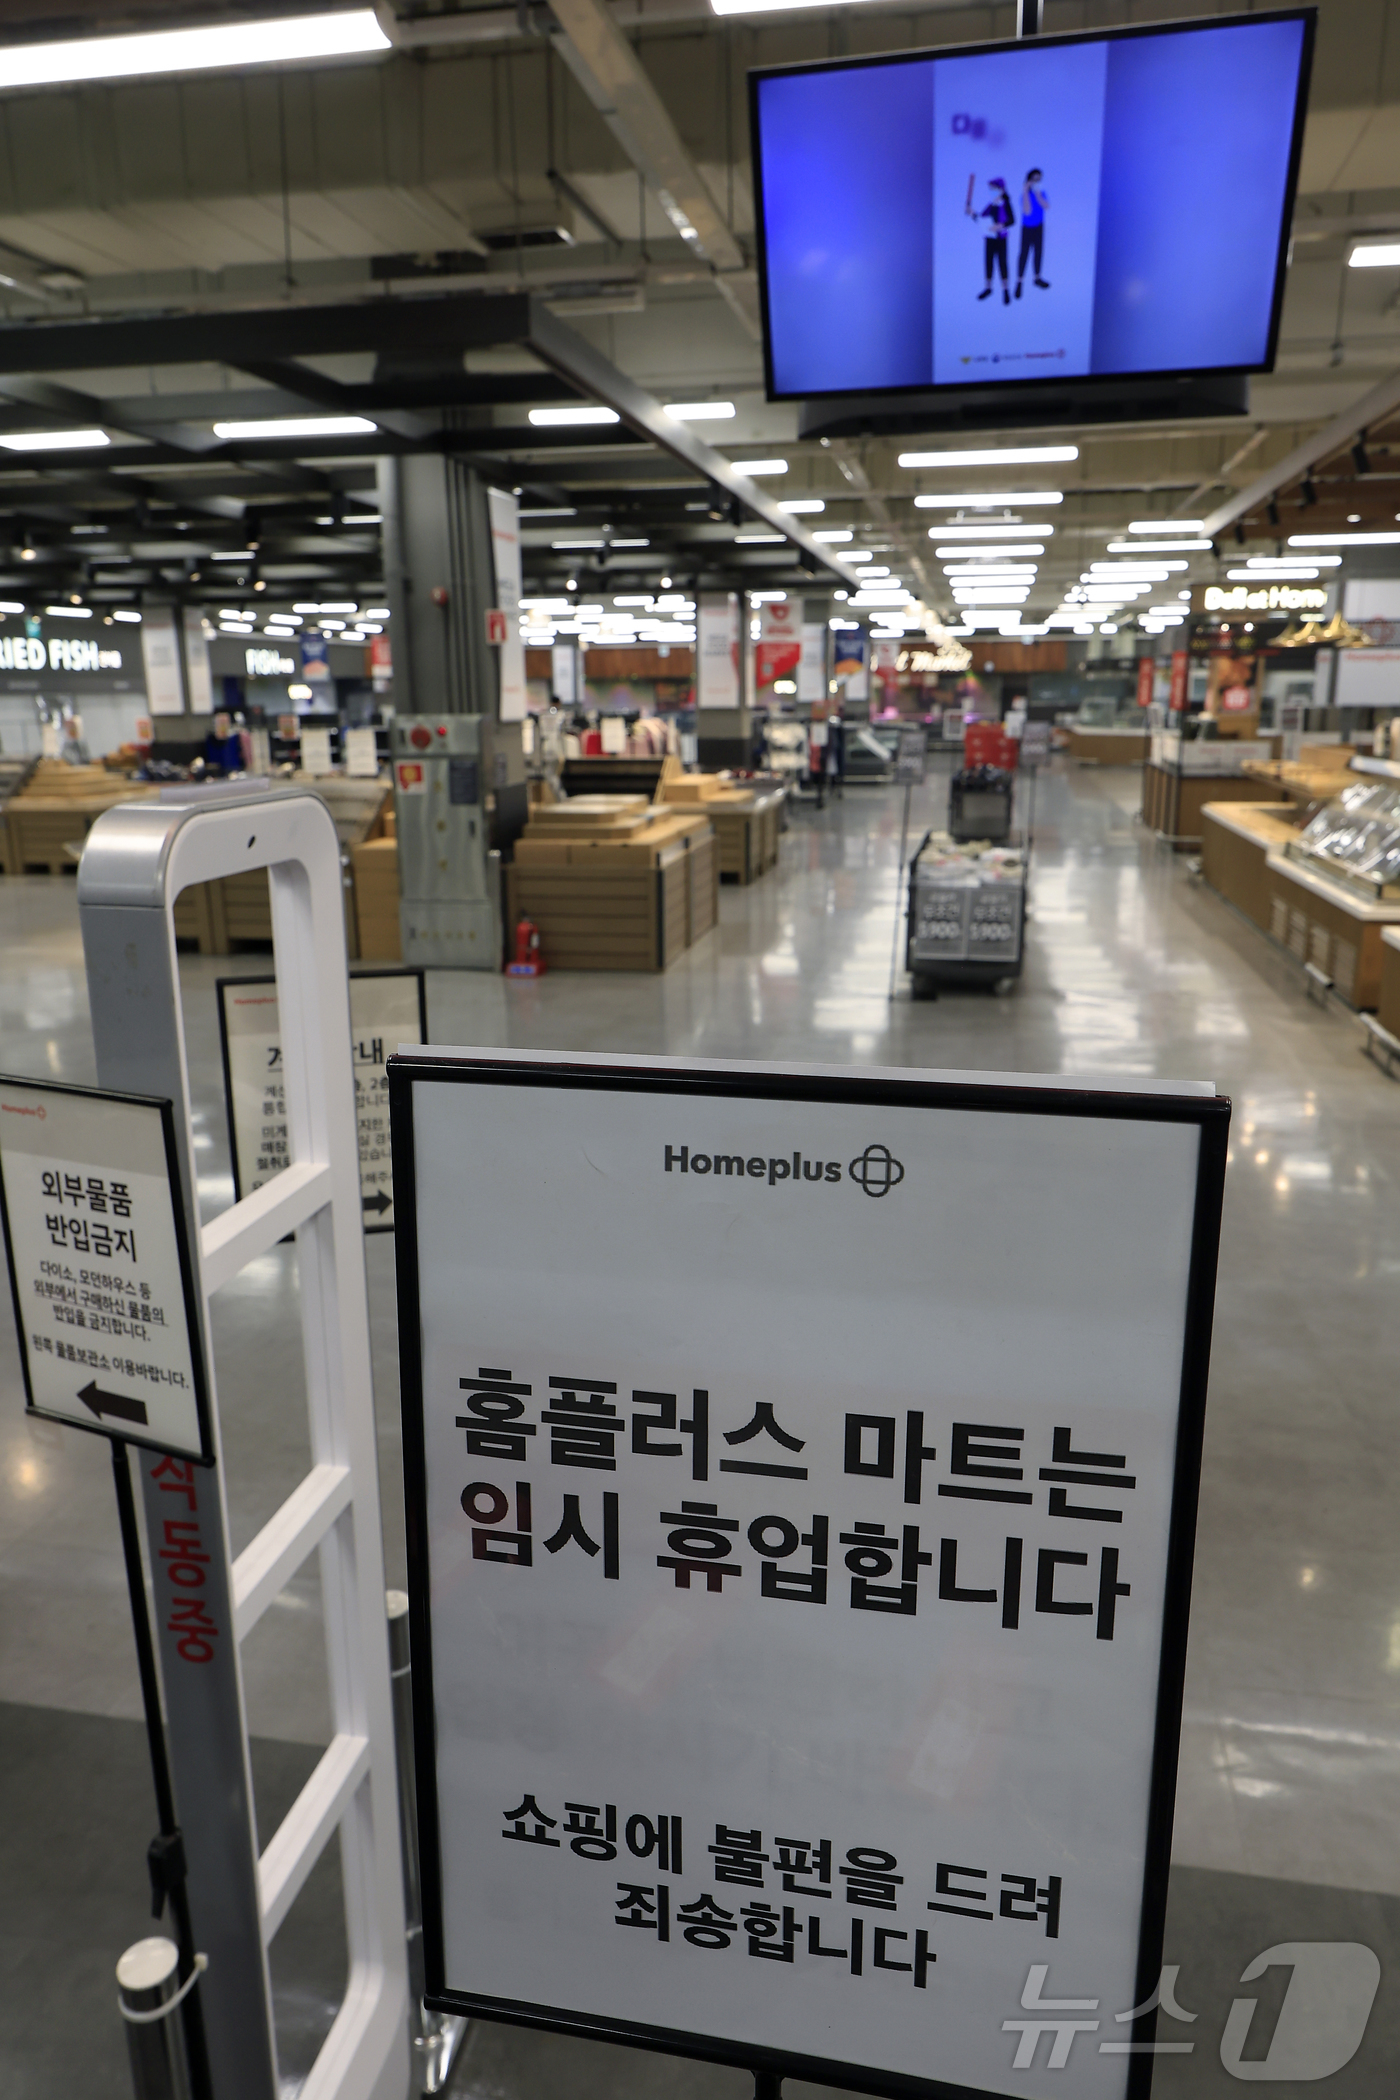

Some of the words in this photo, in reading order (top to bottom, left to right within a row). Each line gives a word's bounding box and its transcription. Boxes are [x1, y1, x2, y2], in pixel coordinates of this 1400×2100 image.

[1204, 586, 1248, 610] Deli
[1269, 585, 1328, 608] Hom
[48, 638, 99, 671] FISH
[664, 1144, 842, 1186] Homeplus
[41, 1170, 133, 1218] 외부물품
[45, 1213, 138, 1263] 반입금지
[34, 1279, 77, 1304] 외부에서
[80, 1290, 125, 1317] 구매하신
[128, 1301, 165, 1325] 물품의
[40, 1260, 77, 1284] 다이소,
[79, 1269, 137, 1296] 모던하우스
[140, 1282, 151, 1300] 등
[53, 1304, 86, 1327] 반입을
[89, 1312, 151, 1341] 금지합니다.
[55, 1340, 110, 1370] 물품보관소
[112, 1357, 189, 1389] 이용바랍니다.
[455, 1367, 808, 1481] 홈플러스
[844, 1410, 1136, 1523] 마트는
[460, 1481, 620, 1580] 임시
[656, 1500, 1131, 1641] 휴업합니다
[501, 1793, 683, 1875] 쇼핑에
[707, 1823, 904, 1911] 불편을
[927, 1862, 1062, 1939] 드려
[614, 1882, 937, 1989] 죄송합니다
